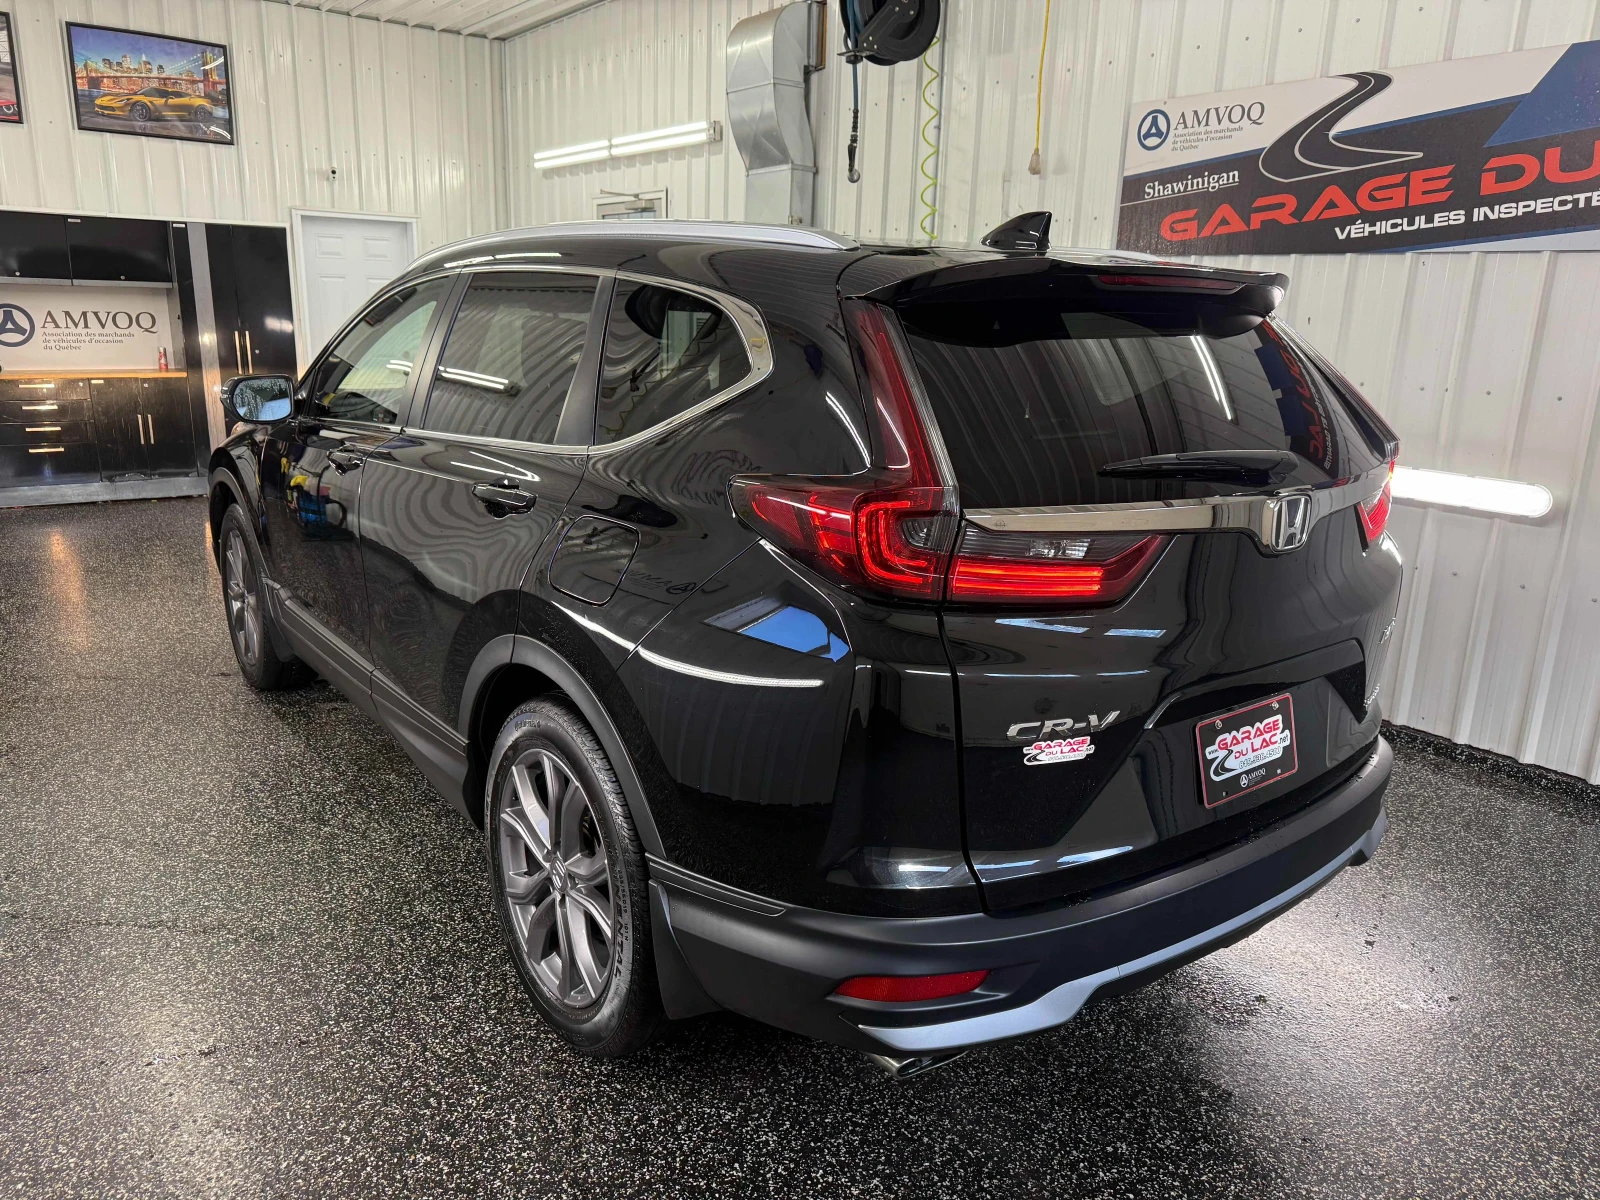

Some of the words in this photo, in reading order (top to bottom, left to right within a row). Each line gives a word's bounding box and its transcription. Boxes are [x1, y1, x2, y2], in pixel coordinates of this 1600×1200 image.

[1173, 102, 1265, 130] AMVOQ
[1172, 130, 1203, 139] Association
[1204, 128, 1213, 136] des
[1214, 125, 1244, 134] marchands
[1179, 136, 1204, 144] véhicules
[1204, 134, 1232, 142] d'occasion
[1179, 143, 1200, 152] Québec
[1144, 170, 1240, 199] Shawinigan
[1160, 164, 1456, 242] GARAGE
[1480, 139, 1600, 196] DU
[1334, 210, 1466, 240] VÉHICULES
[40, 310, 158, 334] AMVOQ
[1006, 710, 1120, 742] CR-V
[1218, 719, 1281, 750] GARAGE
[1034, 738, 1088, 750] GARAGE
[1060, 746, 1084, 754] LAC
[1234, 748, 1248, 760] DU
[1250, 733, 1278, 753] LAC
[1278, 734, 1289, 744] .net
